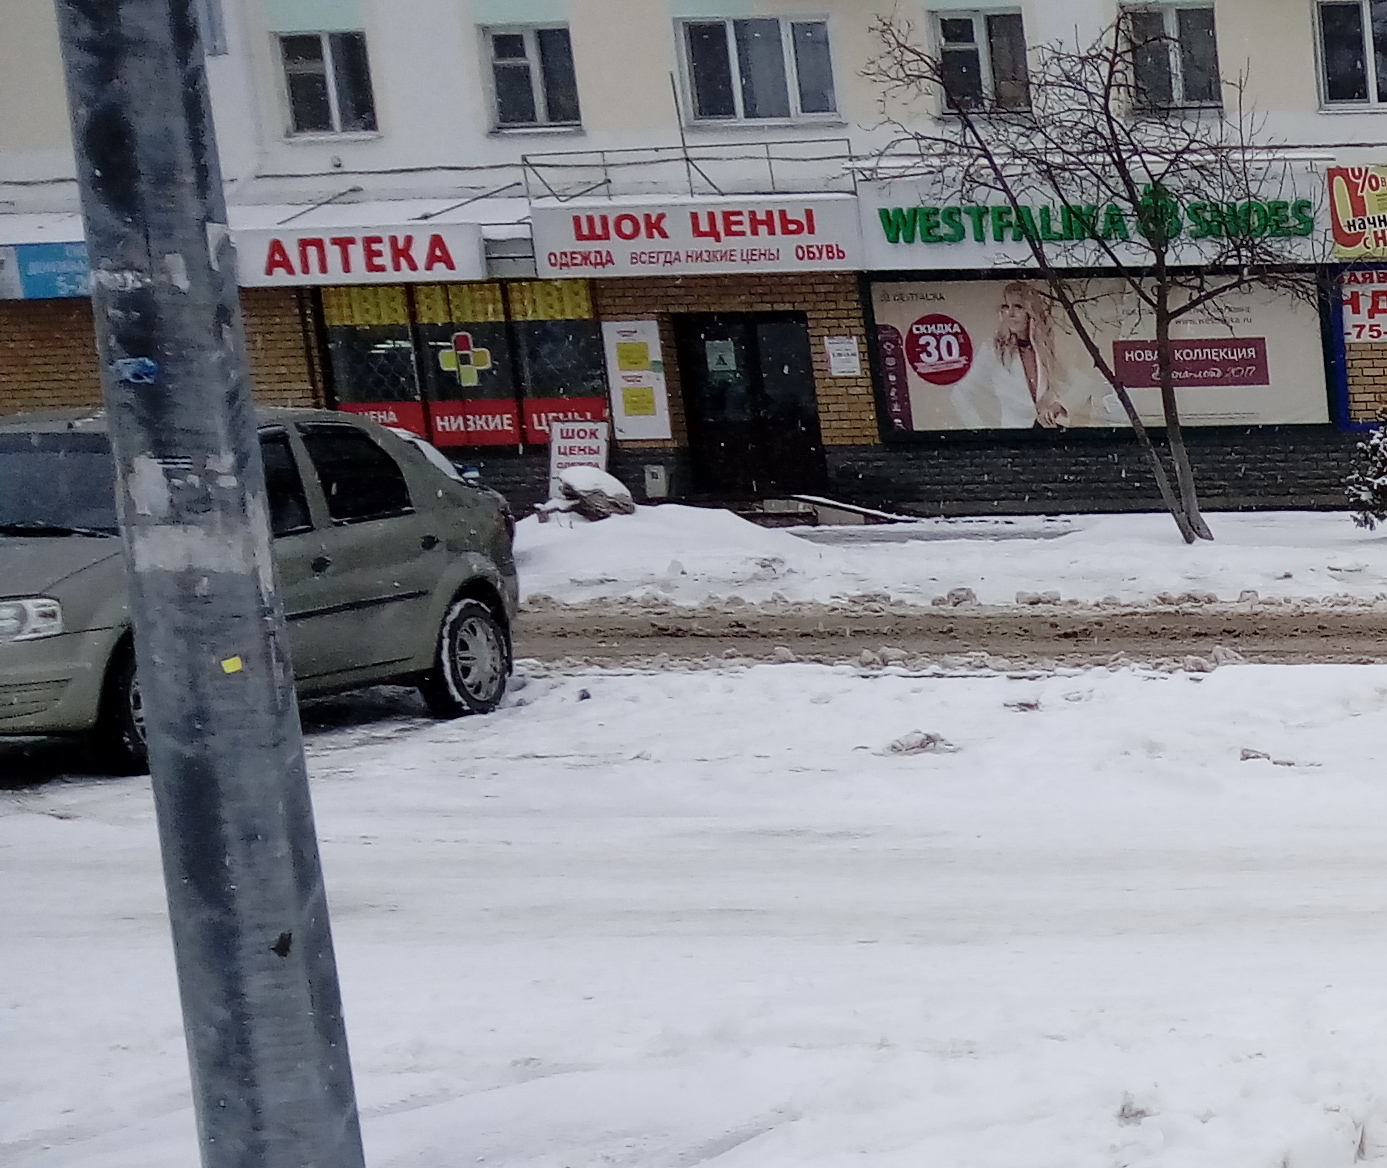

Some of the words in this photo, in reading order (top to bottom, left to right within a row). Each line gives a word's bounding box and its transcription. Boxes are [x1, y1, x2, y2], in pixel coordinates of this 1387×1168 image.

[572, 212, 670, 242] ШОК
[690, 208, 816, 243] ЦЕНЫ
[878, 203, 1129, 243] WESTFALIKA
[1188, 199, 1315, 239] SHOES
[264, 233, 457, 276] АПТЕКА
[547, 250, 615, 270] ОДЕЖДА
[630, 250, 682, 267] ВСЕГДА
[686, 248, 737, 264] НИЗКИЕ
[741, 247, 780, 263] ЦЕНЫ
[795, 243, 846, 261] ОБУВЬ
[912, 323, 961, 335] СКИДКА
[1174, 347, 1256, 362] КОЛЛЕКЦИЯ
[435, 413, 514, 433] НИЗКИЕ
[559, 427, 600, 441] ШОК
[557, 444, 601, 457] ЦЕНЫ
